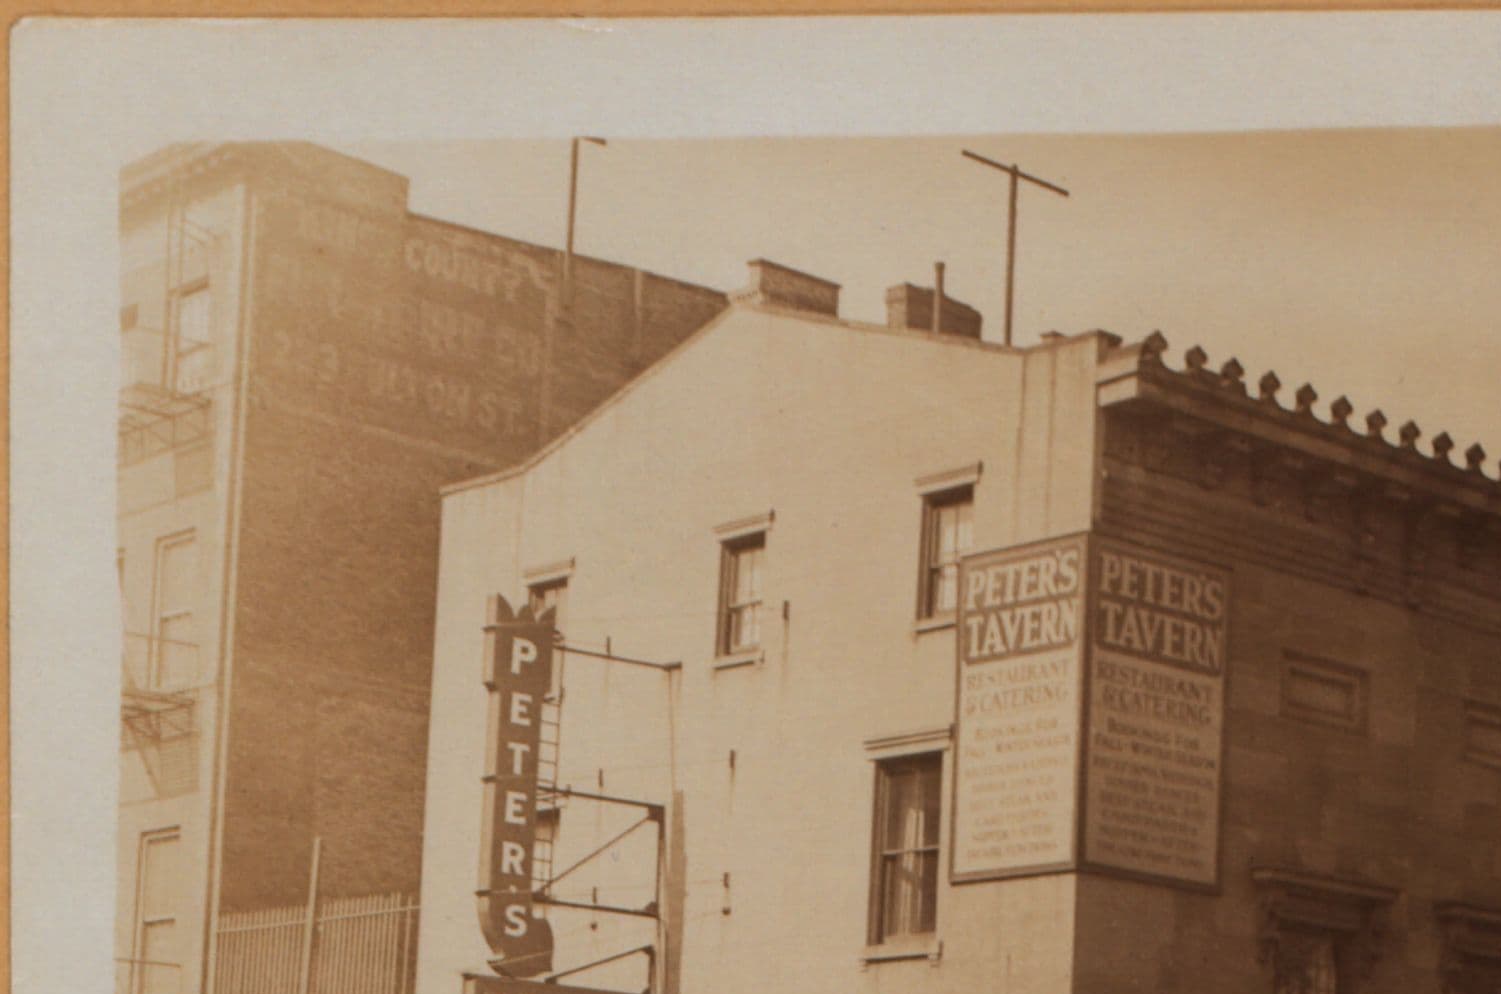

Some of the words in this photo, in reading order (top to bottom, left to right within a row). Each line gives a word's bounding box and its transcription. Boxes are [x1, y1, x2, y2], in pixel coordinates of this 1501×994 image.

[967, 550, 1079, 611] PETER'S
[1099, 552, 1224, 620] PETER'S
[966, 598, 1079, 659] TAVERN
[1099, 602, 1224, 669] TAVERN
[966, 659, 1069, 691] RESTAURANT
[980, 684, 1070, 713] CATERING
[1096, 661, 1213, 704] RESTAURANT
[1119, 687, 1213, 726] CATERING
[501, 637, 539, 938] PETER'S
